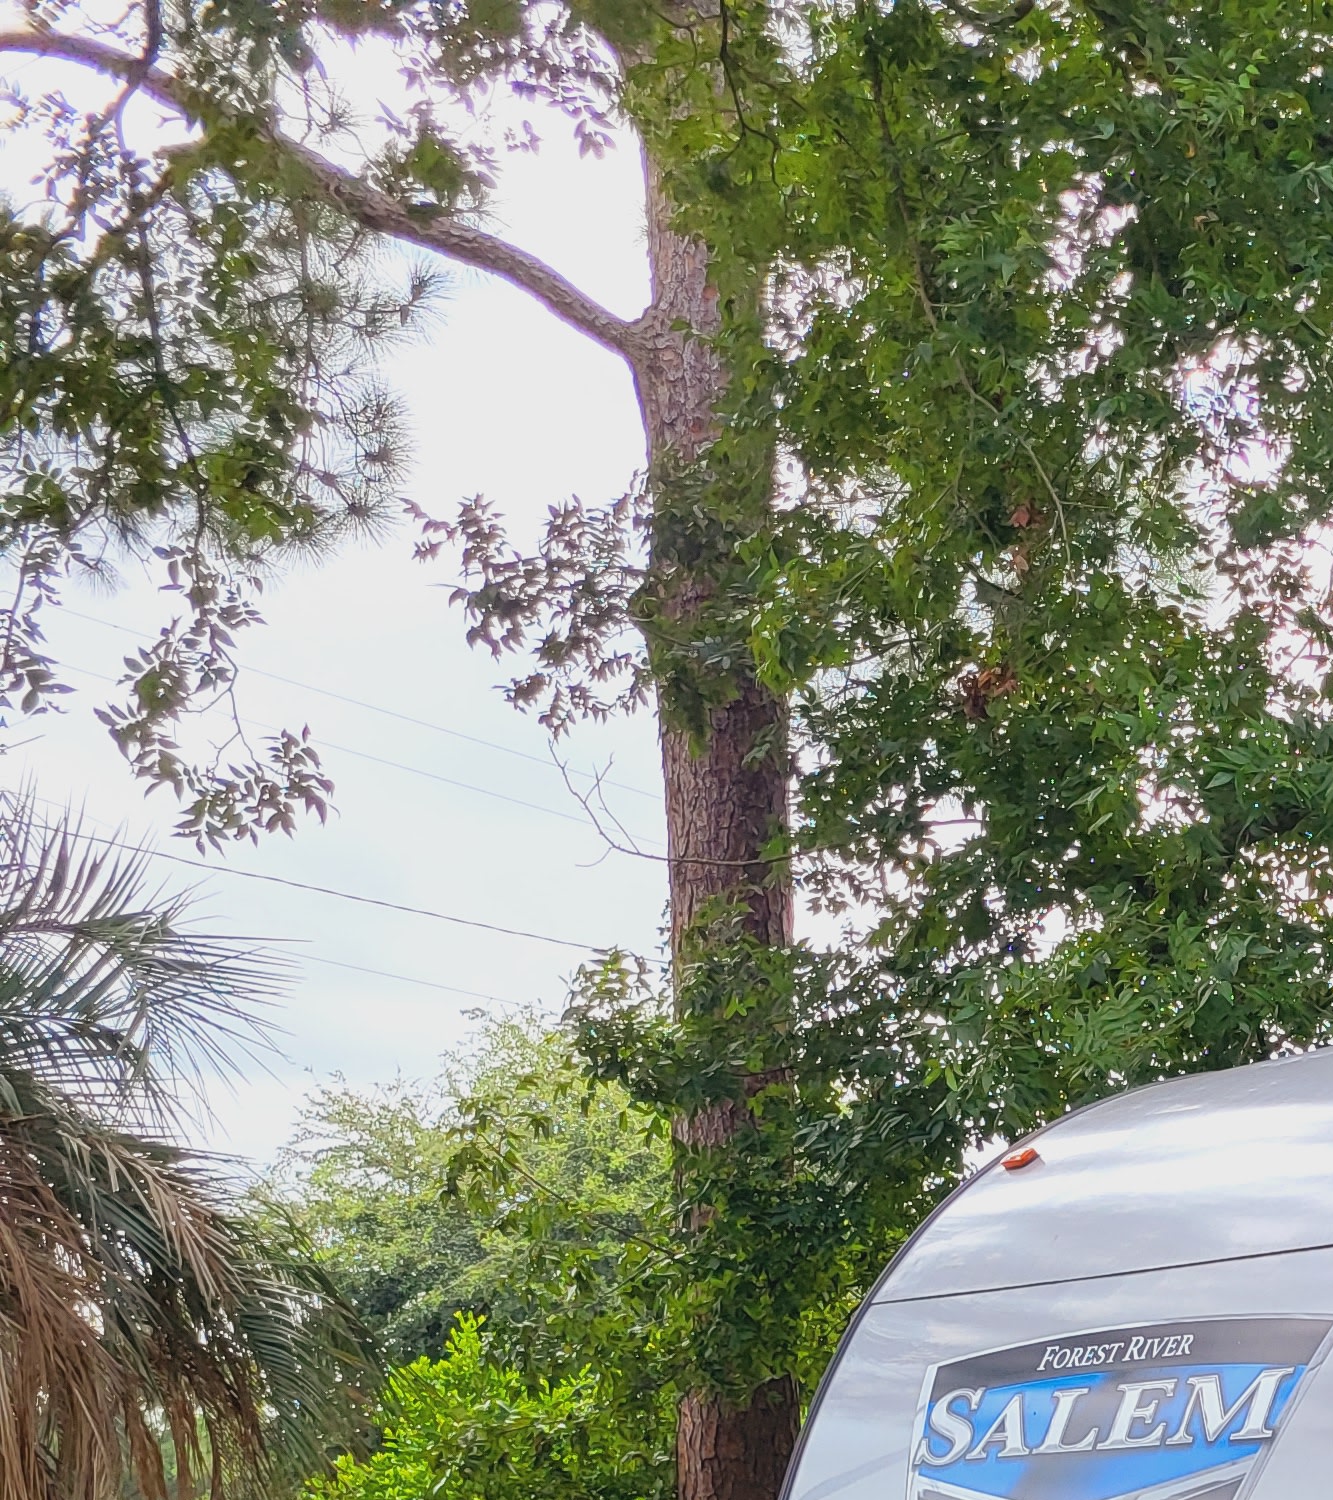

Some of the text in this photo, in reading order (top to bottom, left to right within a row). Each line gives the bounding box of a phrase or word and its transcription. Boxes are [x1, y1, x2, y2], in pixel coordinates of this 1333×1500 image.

[1036, 1334, 1194, 1371] FOREST RIVER
[914, 1366, 1295, 1467] SALEM
